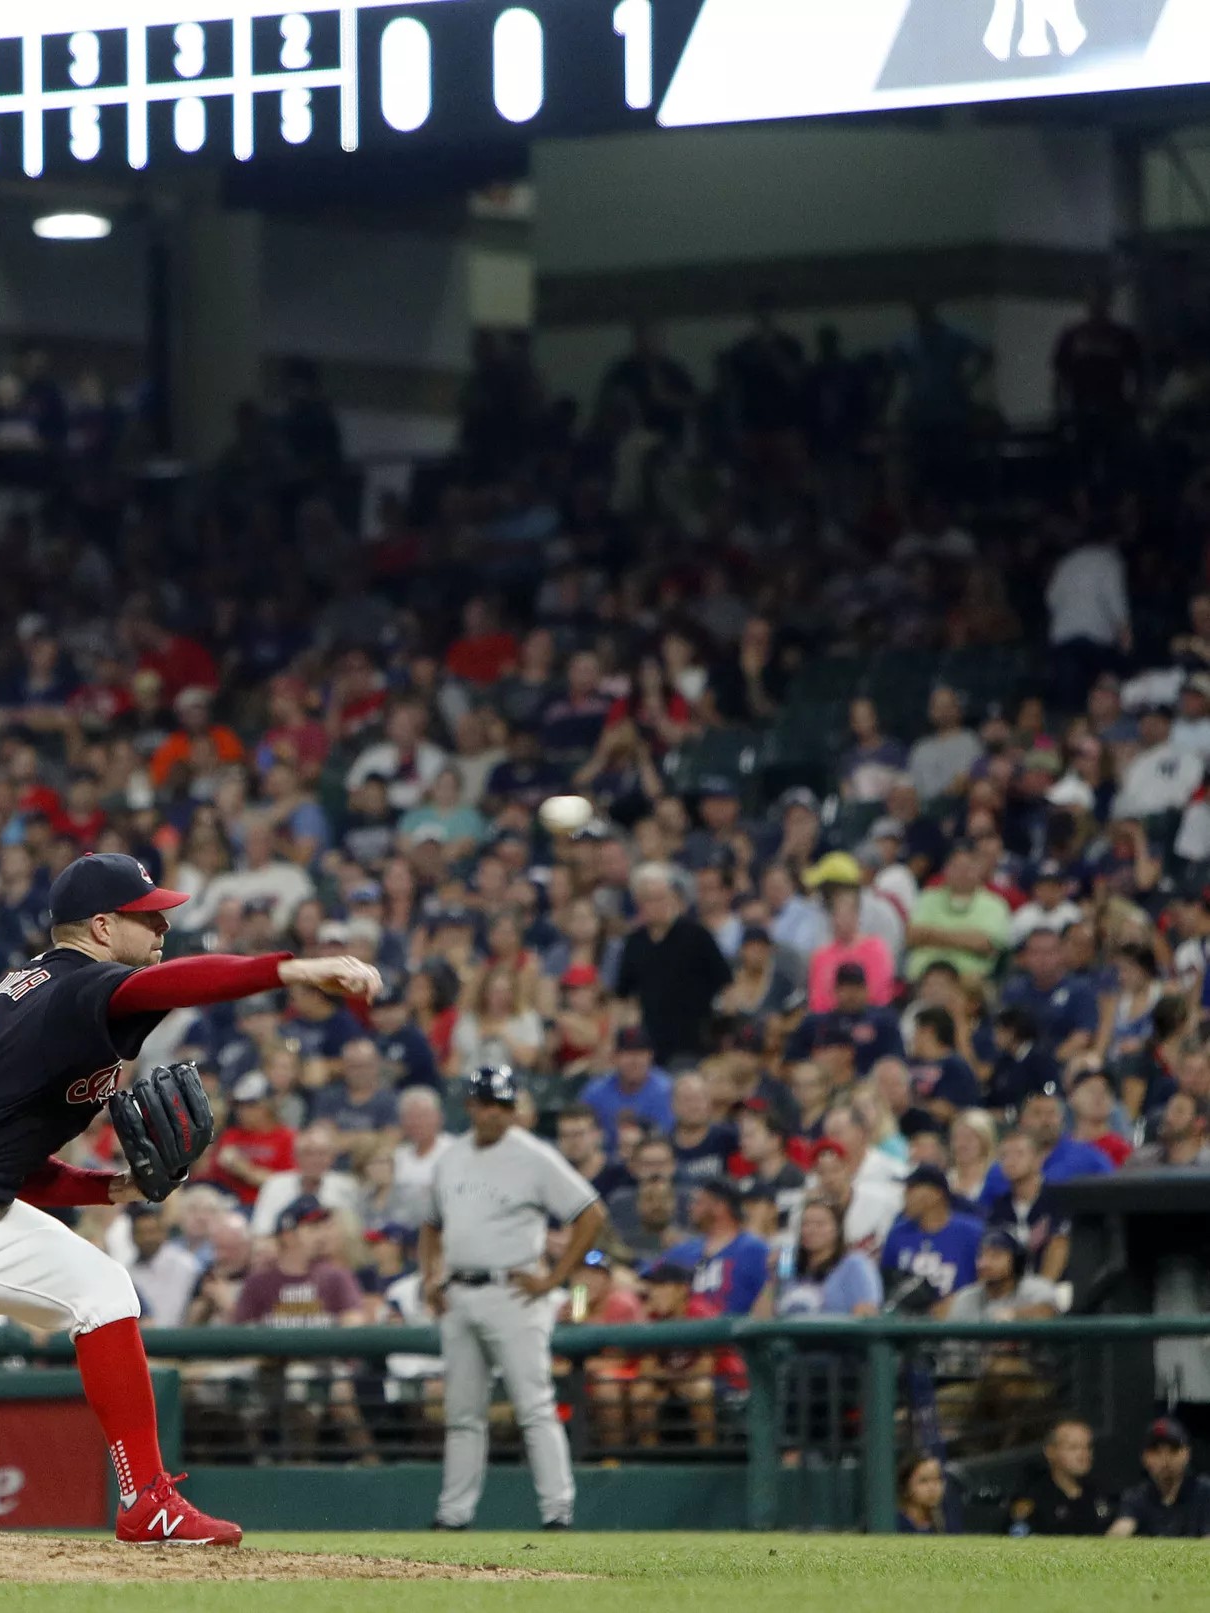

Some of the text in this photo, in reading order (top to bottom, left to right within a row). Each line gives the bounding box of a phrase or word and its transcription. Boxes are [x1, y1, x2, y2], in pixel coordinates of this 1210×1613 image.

[68, 31, 100, 87] 3
[174, 22, 205, 78] 3
[381, 0, 653, 132] 0 0 1
[174, 96, 206, 152] 0
[148, 1508, 184, 1537] N
